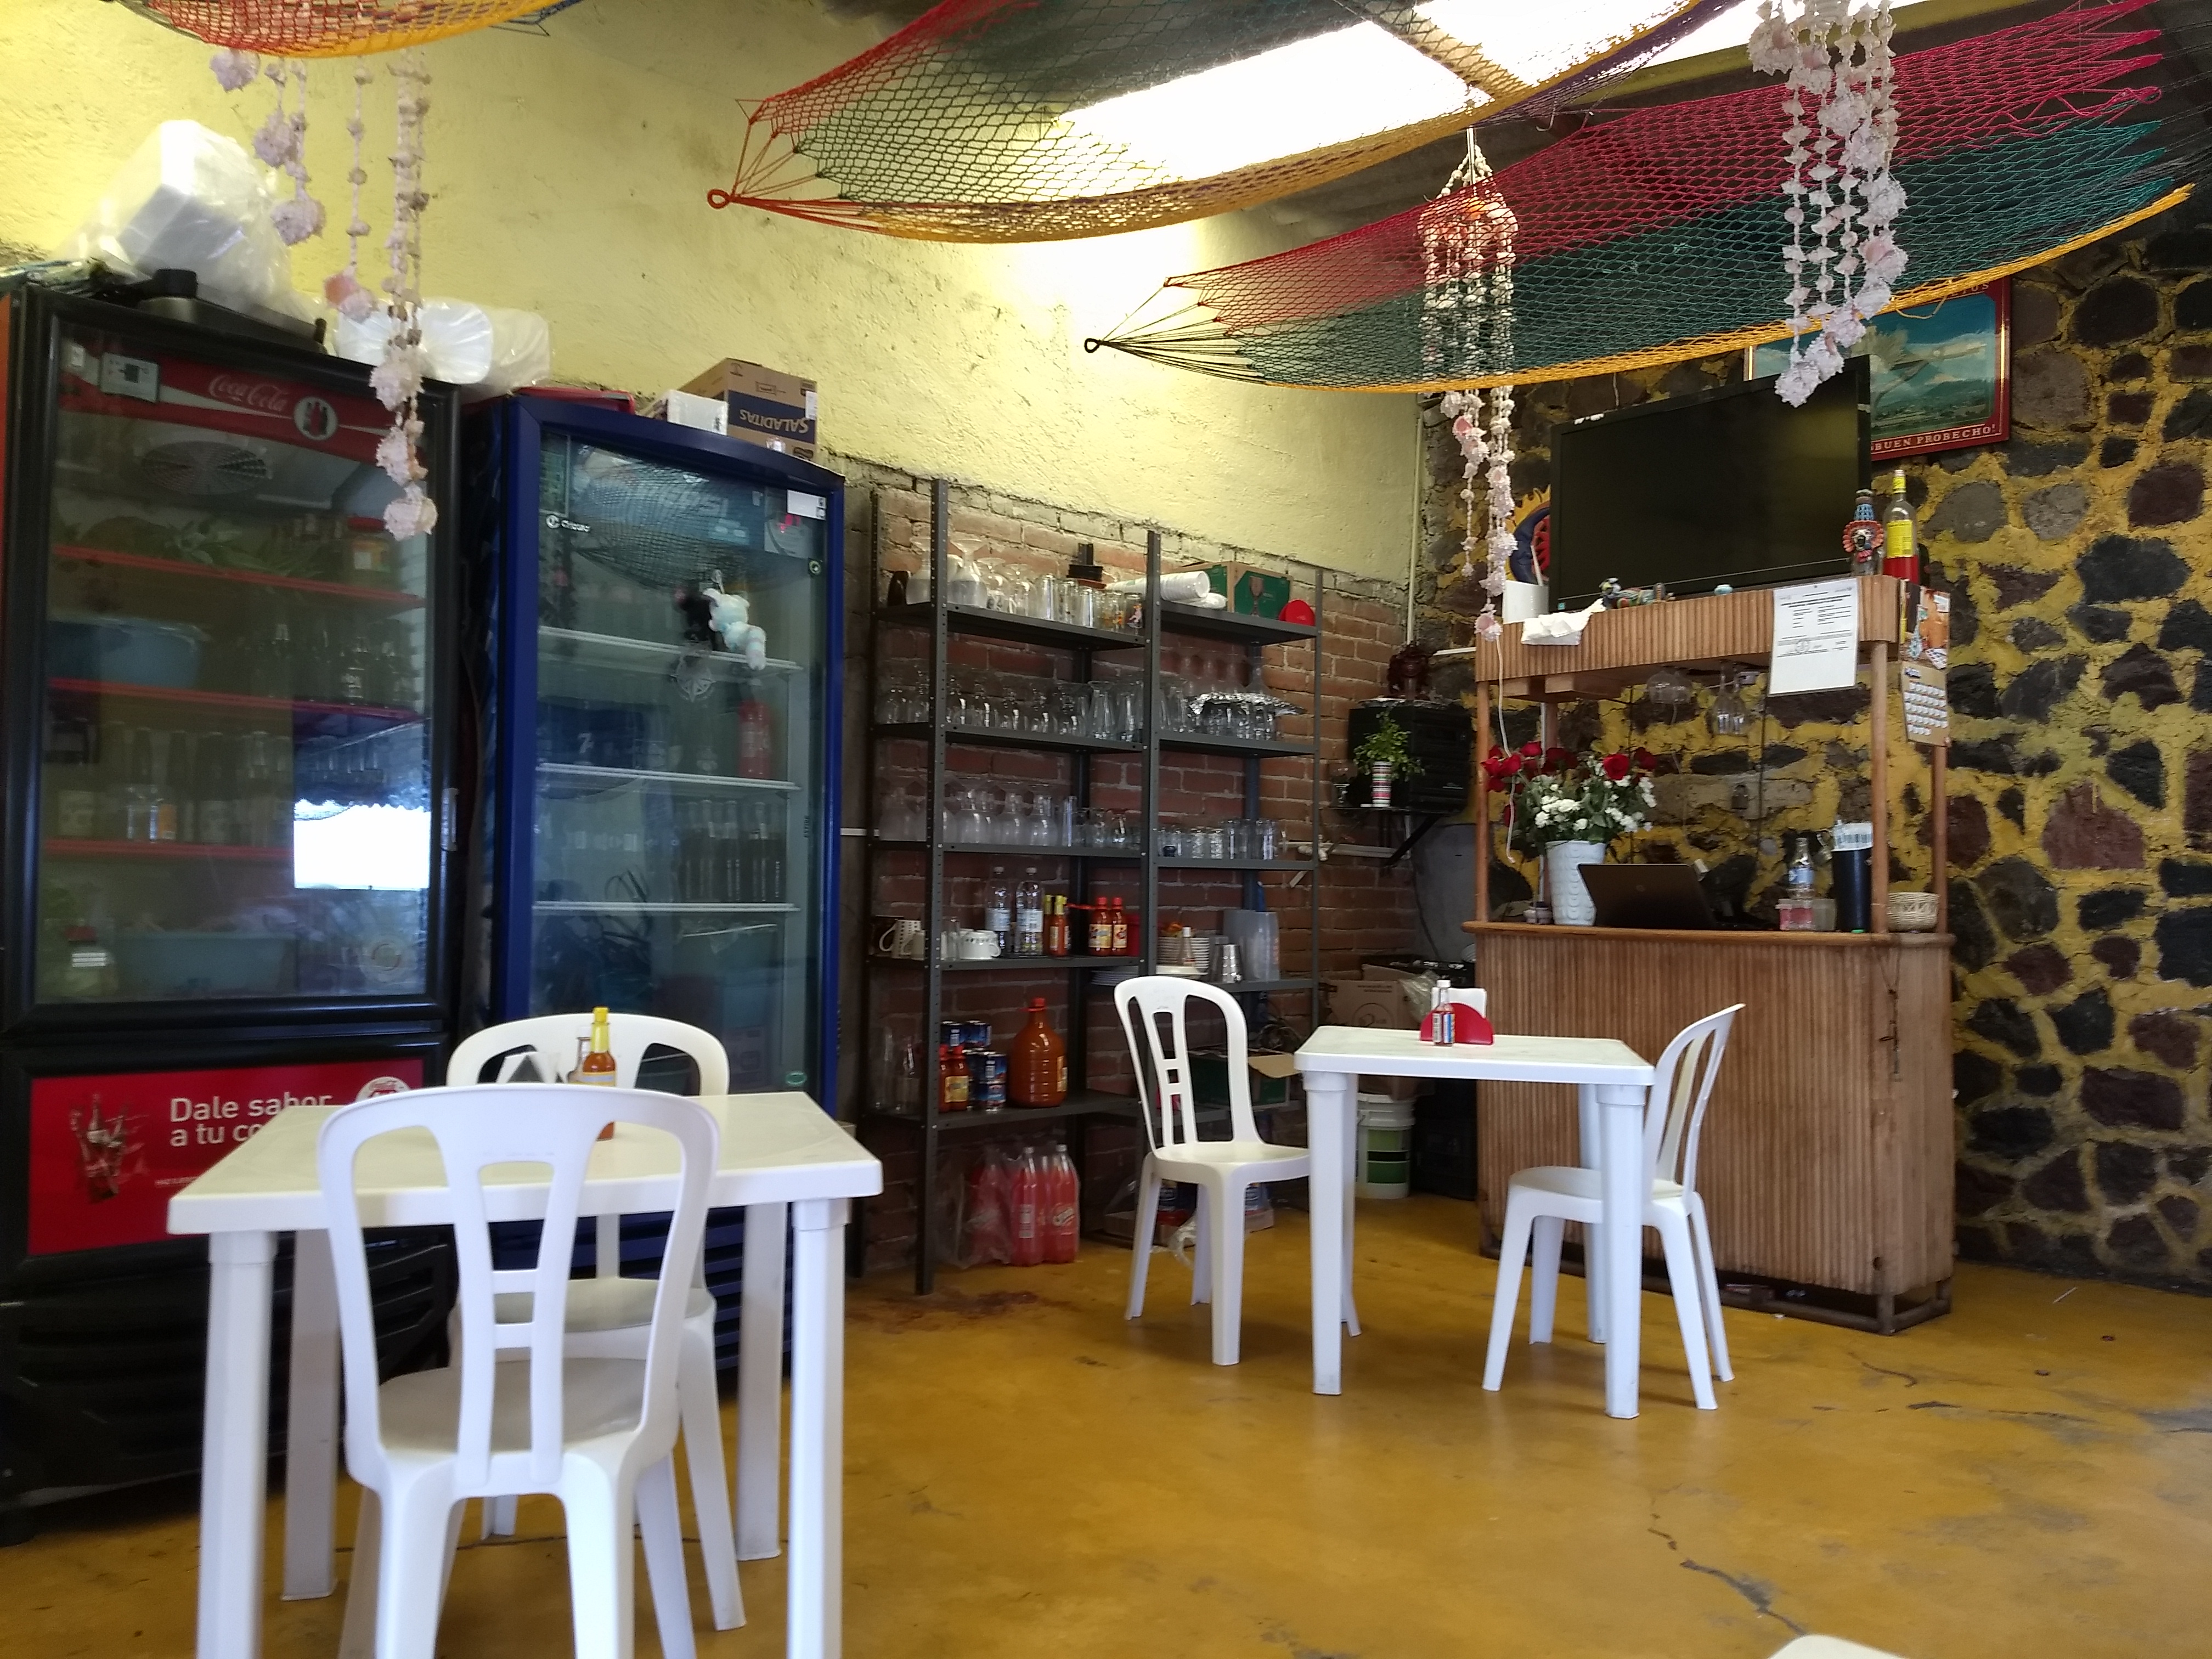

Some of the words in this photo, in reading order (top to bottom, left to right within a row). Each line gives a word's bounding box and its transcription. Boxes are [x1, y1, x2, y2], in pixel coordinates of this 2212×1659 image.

[208, 374, 289, 411] Coca-Cola
[739, 408, 809, 434] SALADITAS
[1916, 424, 1996, 444] PROBECHO!
[170, 1096, 240, 1122] Dale
[170, 1128, 188, 1147] a
[196, 1124, 225, 1144] tu
